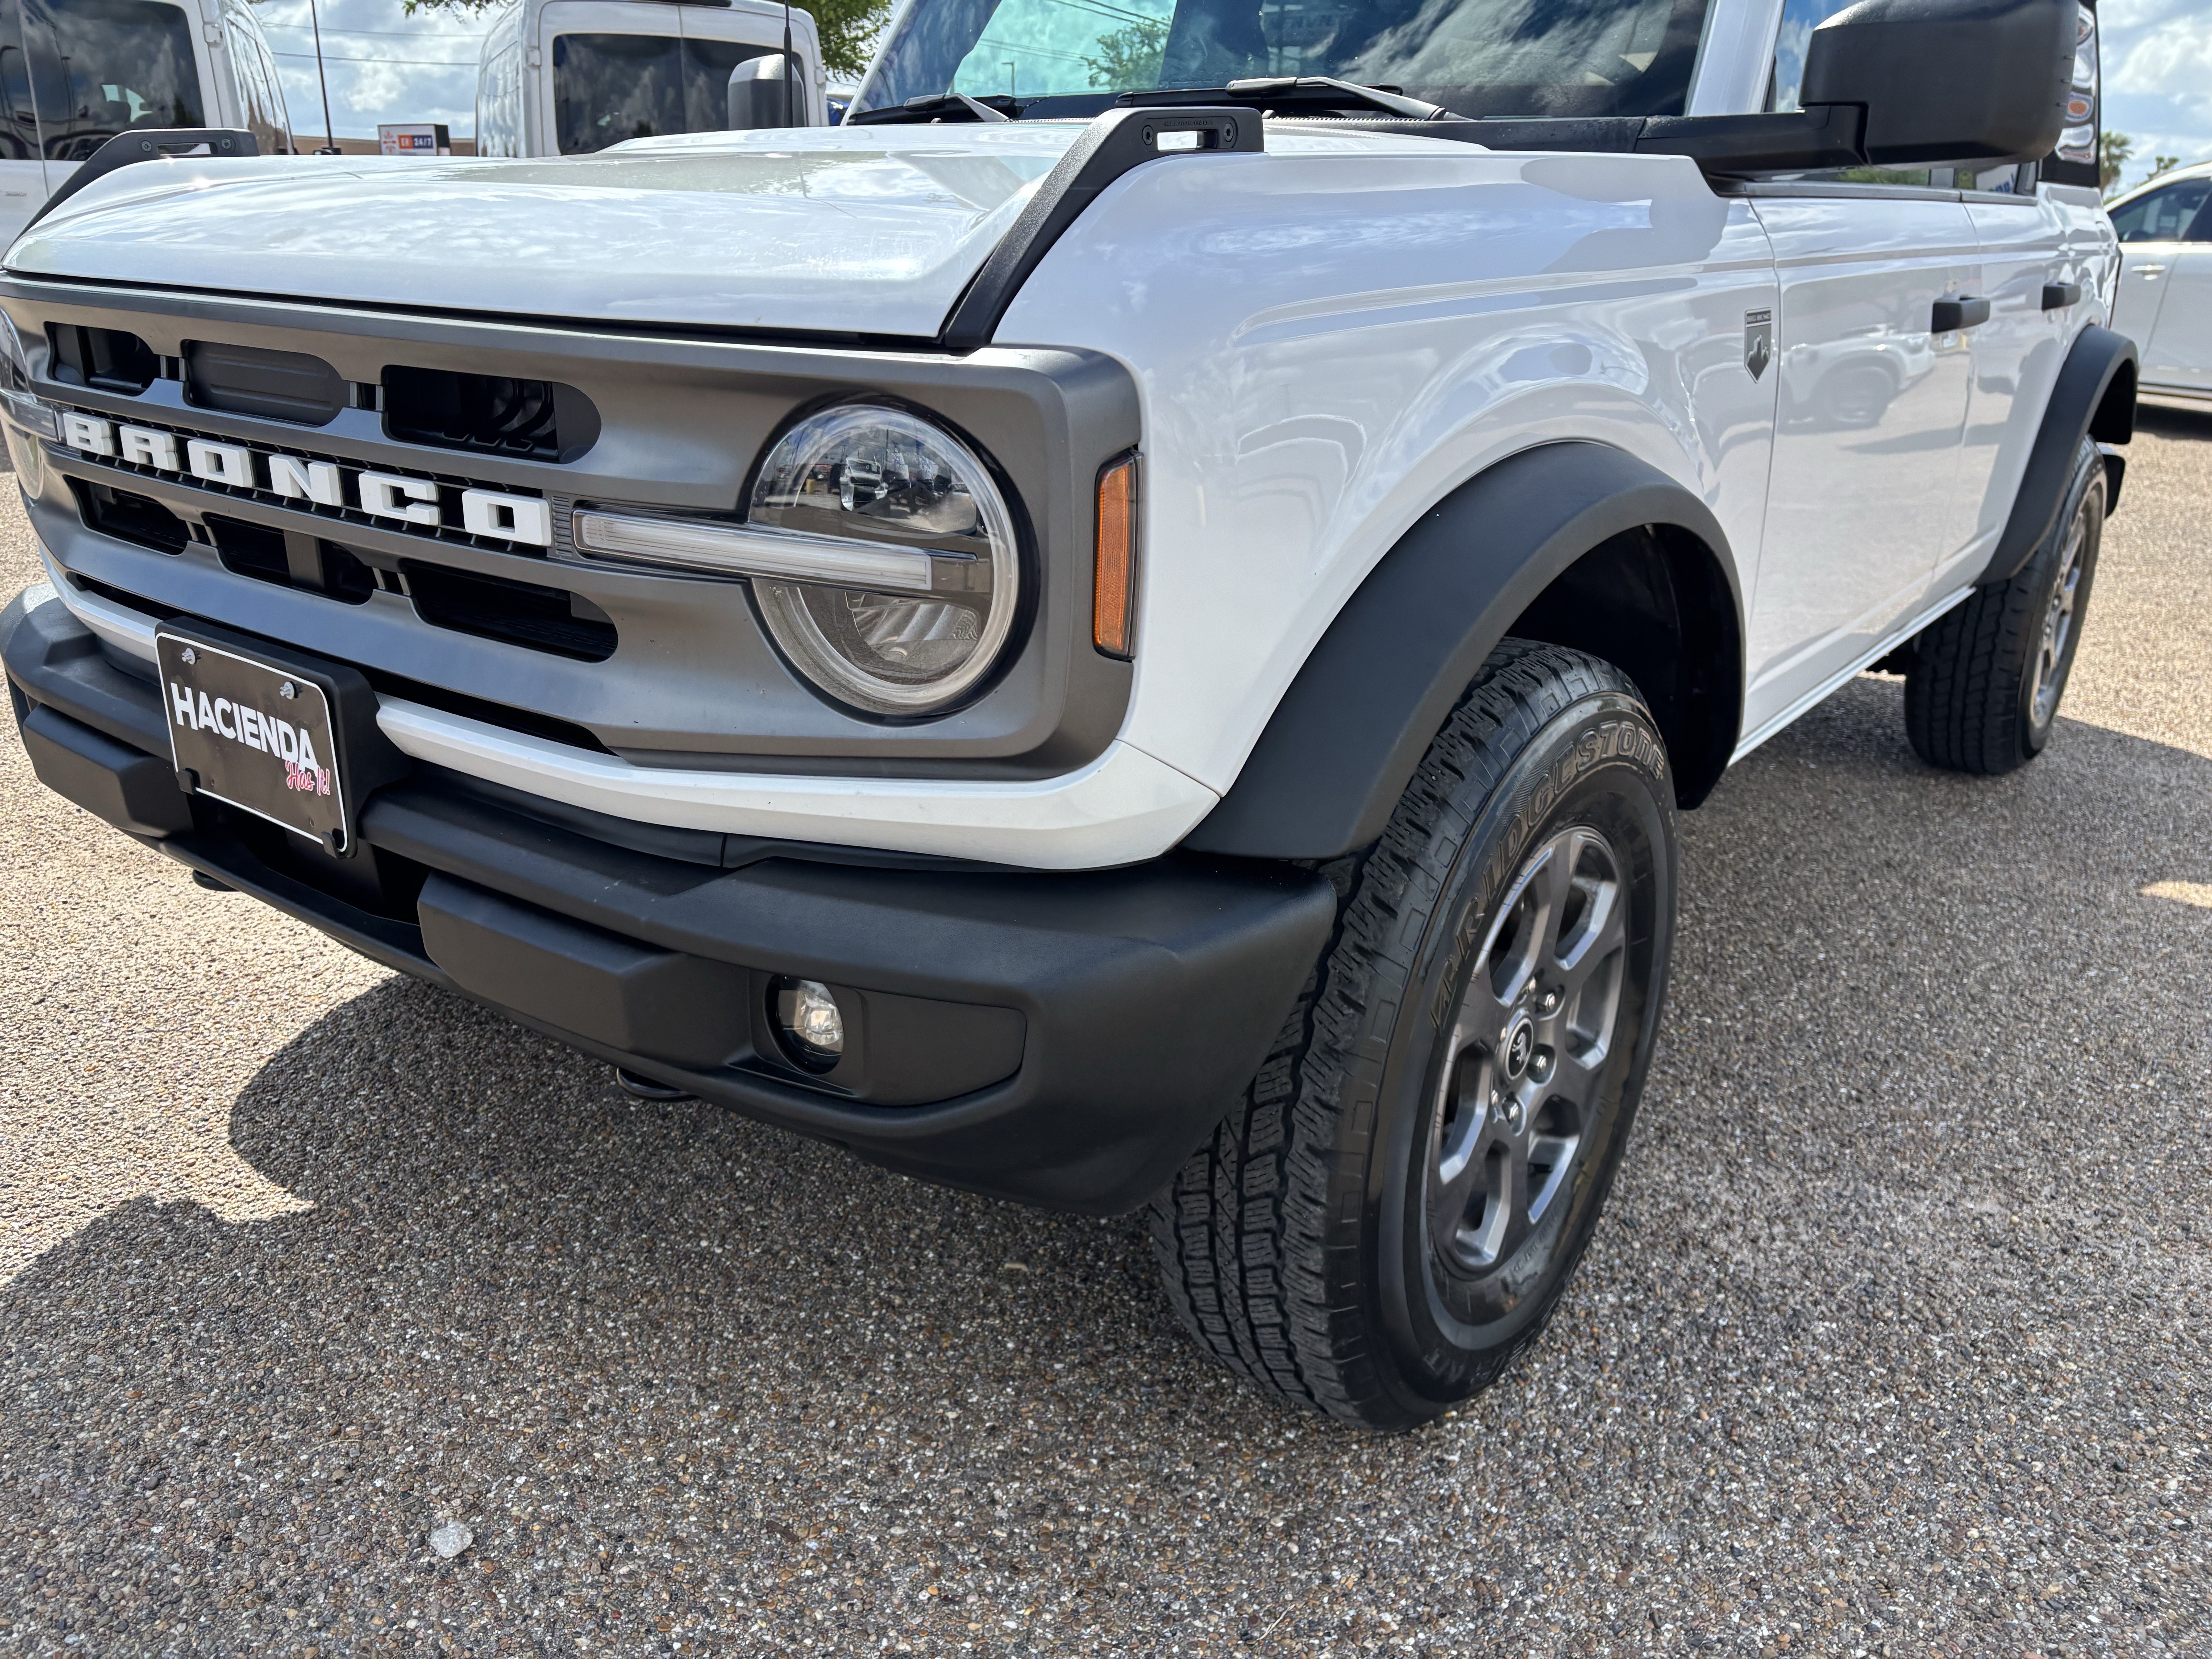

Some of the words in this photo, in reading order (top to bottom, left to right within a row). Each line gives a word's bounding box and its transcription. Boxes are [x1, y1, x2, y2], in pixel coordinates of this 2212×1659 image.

[414, 137, 431, 146] 24/7
[63, 411, 553, 546] BRONCO
[170, 682, 318, 777] HACIENDA
[285, 760, 315, 792] Has
[316, 765, 330, 796] It!
